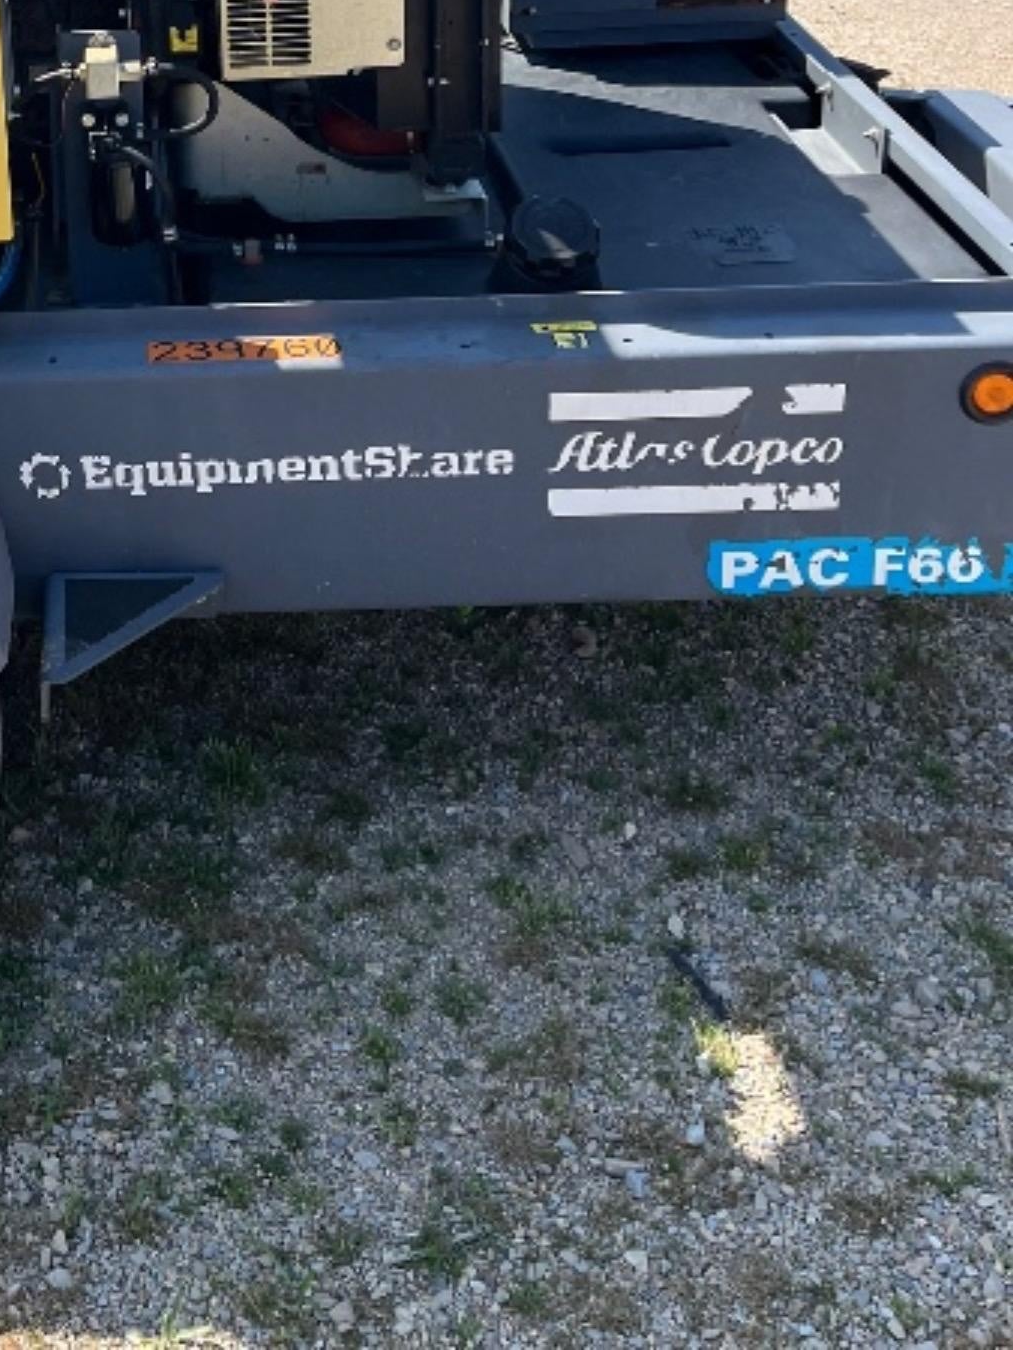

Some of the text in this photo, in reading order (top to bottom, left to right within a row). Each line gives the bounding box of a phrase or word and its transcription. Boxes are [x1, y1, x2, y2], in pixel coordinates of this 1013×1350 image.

[152, 334, 342, 363] 239760
[79, 445, 515, 496] EquipmentShare
[720, 547, 850, 590] PAC
